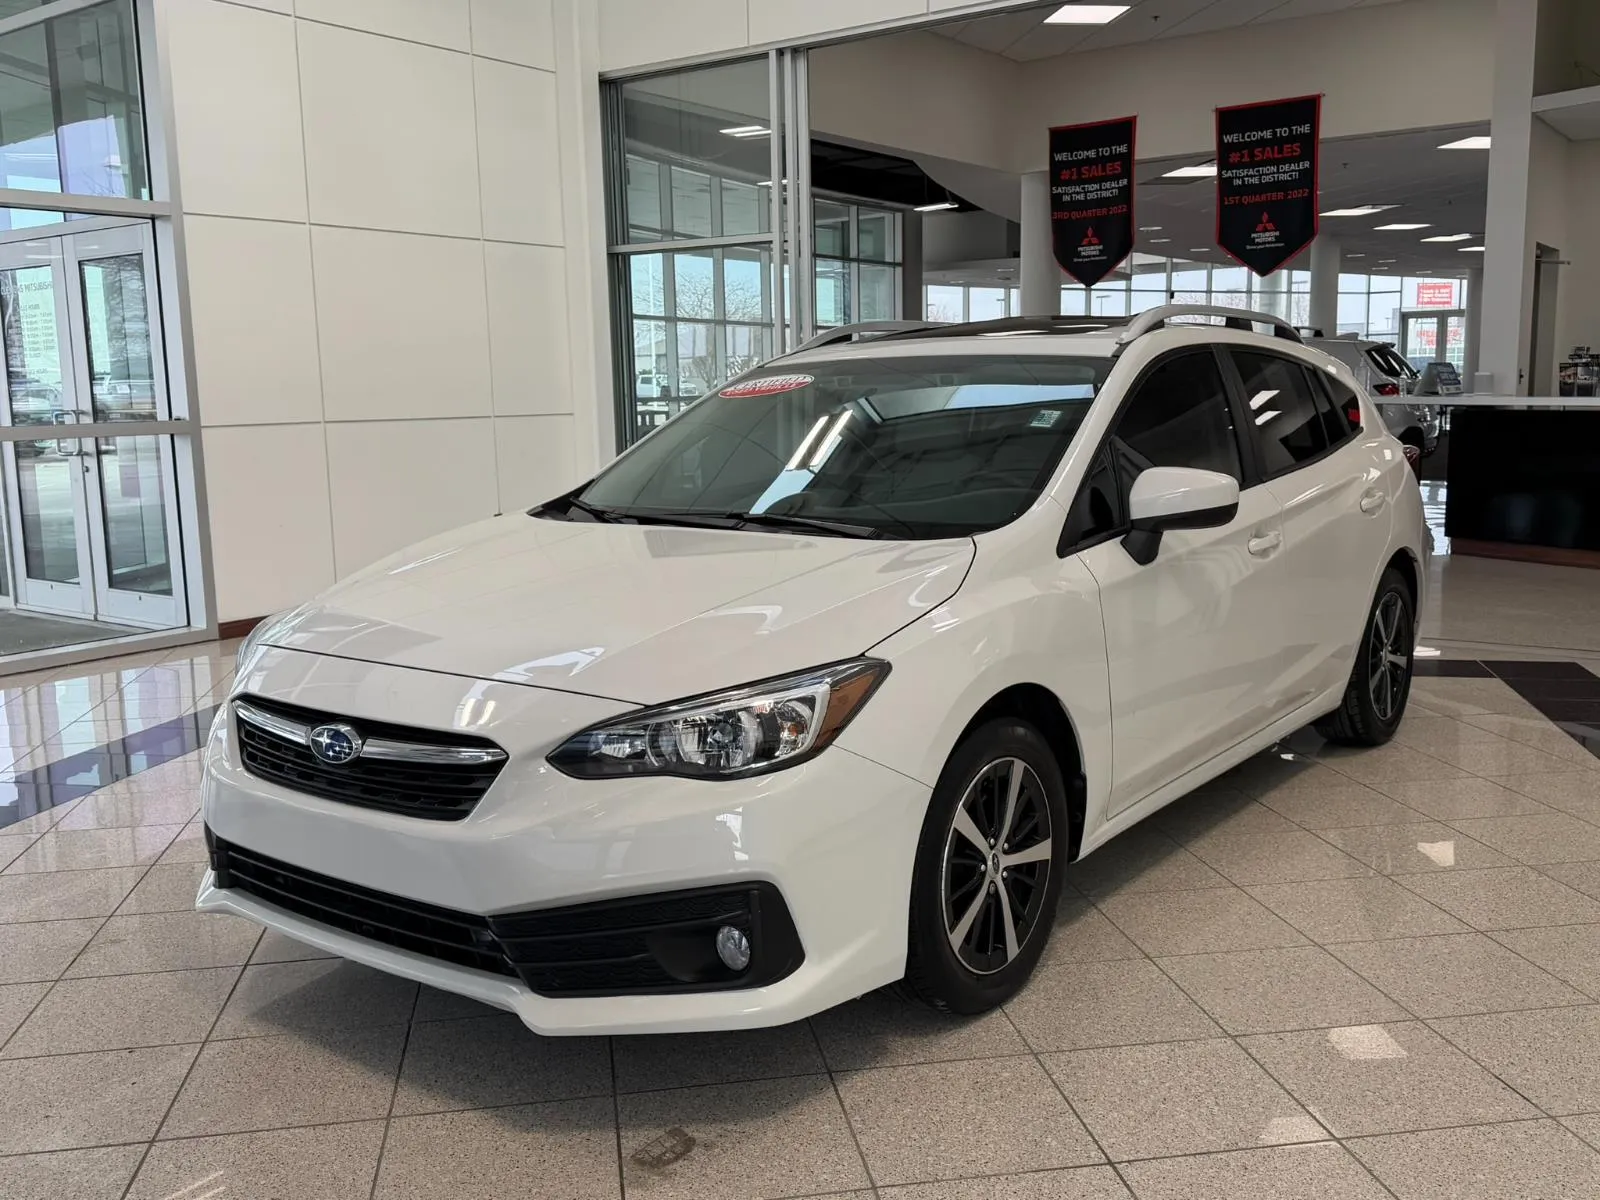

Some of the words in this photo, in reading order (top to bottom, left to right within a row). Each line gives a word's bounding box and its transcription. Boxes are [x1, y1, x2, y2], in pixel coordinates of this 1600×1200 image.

[1223, 129, 1273, 143] WELCOME
[1275, 127, 1289, 137] TO
[1291, 123, 1311, 135] THE
[1054, 149, 1097, 161] WELCOME
[1098, 147, 1110, 156] TO
[1111, 144, 1128, 155] THE
[1228, 149, 1250, 163] #1
[1254, 143, 1301, 160] SALES
[1060, 168, 1078, 180] #1
[1081, 161, 1122, 178] SALES
[1221, 165, 1277, 178] SATISFACTION
[1279, 161, 1310, 173] DEALER
[1052, 183, 1100, 194] SATISFACTION
[1101, 179, 1128, 190] DEALER
[1233, 178, 1242, 186] IN
[1243, 176, 1260, 185] THE
[1261, 171, 1299, 183] DISTRICT!
[1062, 194, 1071, 202] IN
[1071, 193, 1086, 201] THE
[1224, 196, 1240, 205] 1ST
[1241, 192, 1284, 205] QUARTER
[1287, 189, 1309, 199] 2022
[1052, 211, 1070, 220] 3RD
[1071, 208, 1108, 219] QUARTER
[1108, 204, 1128, 214] 2022
